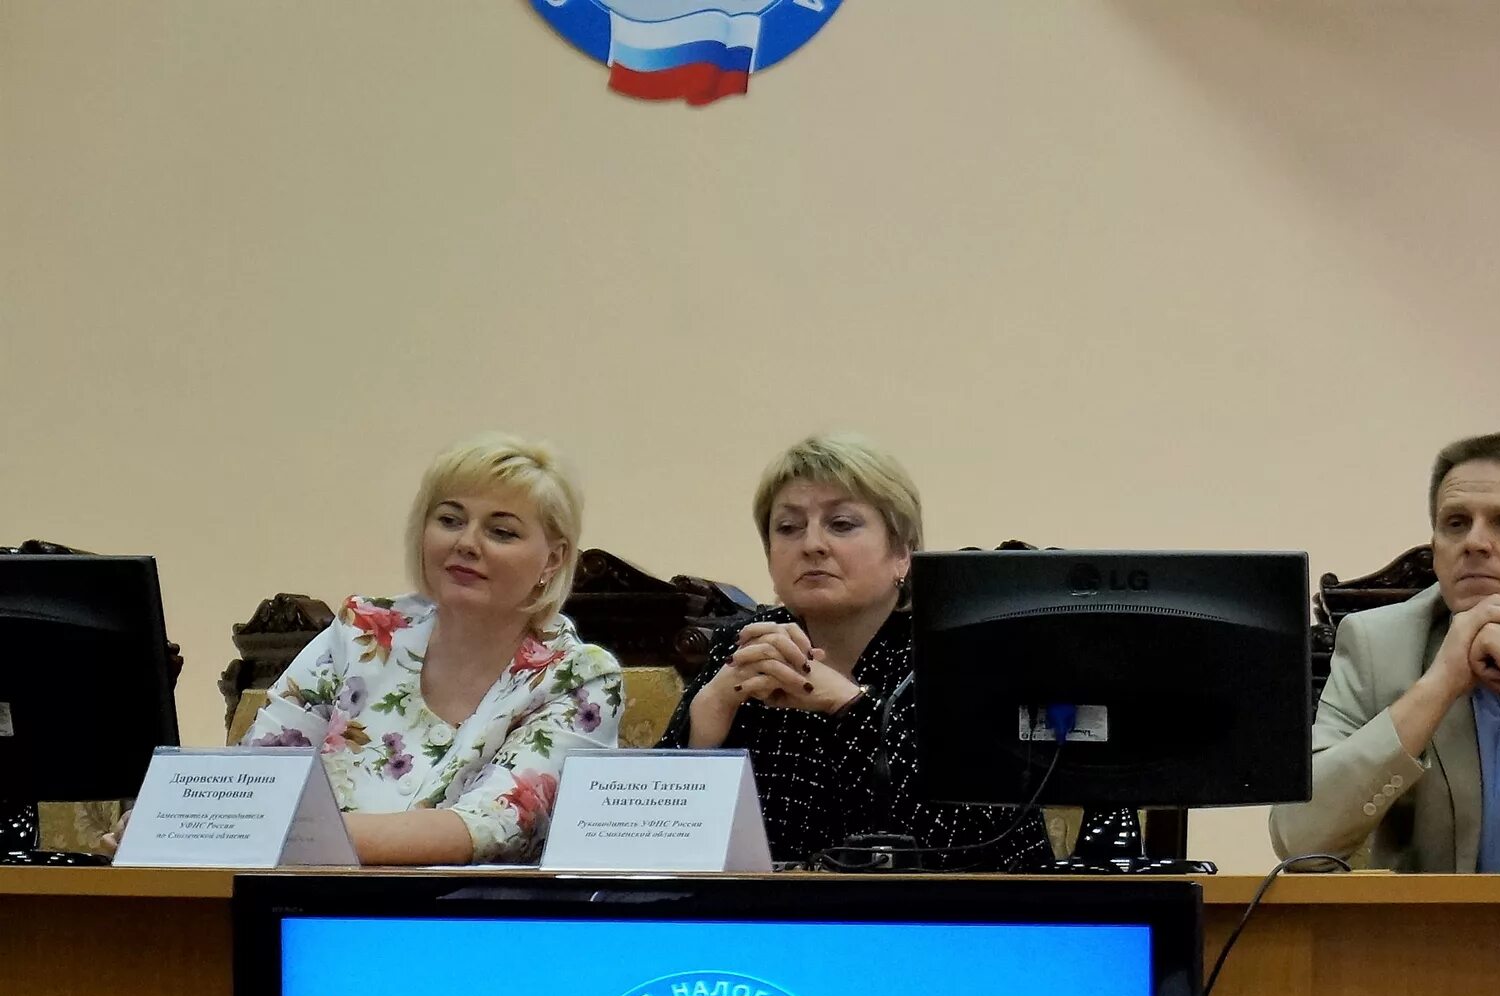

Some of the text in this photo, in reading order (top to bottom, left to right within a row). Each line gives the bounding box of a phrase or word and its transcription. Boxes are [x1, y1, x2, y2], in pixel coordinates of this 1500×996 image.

[1109, 569, 1149, 592] LG
[169, 773, 276, 785] Даровских Ирина
[589, 780, 706, 791] Рыбалко Татьяна
[182, 788, 254, 800] Викторовна
[602, 796, 688, 807] Анатольевна
